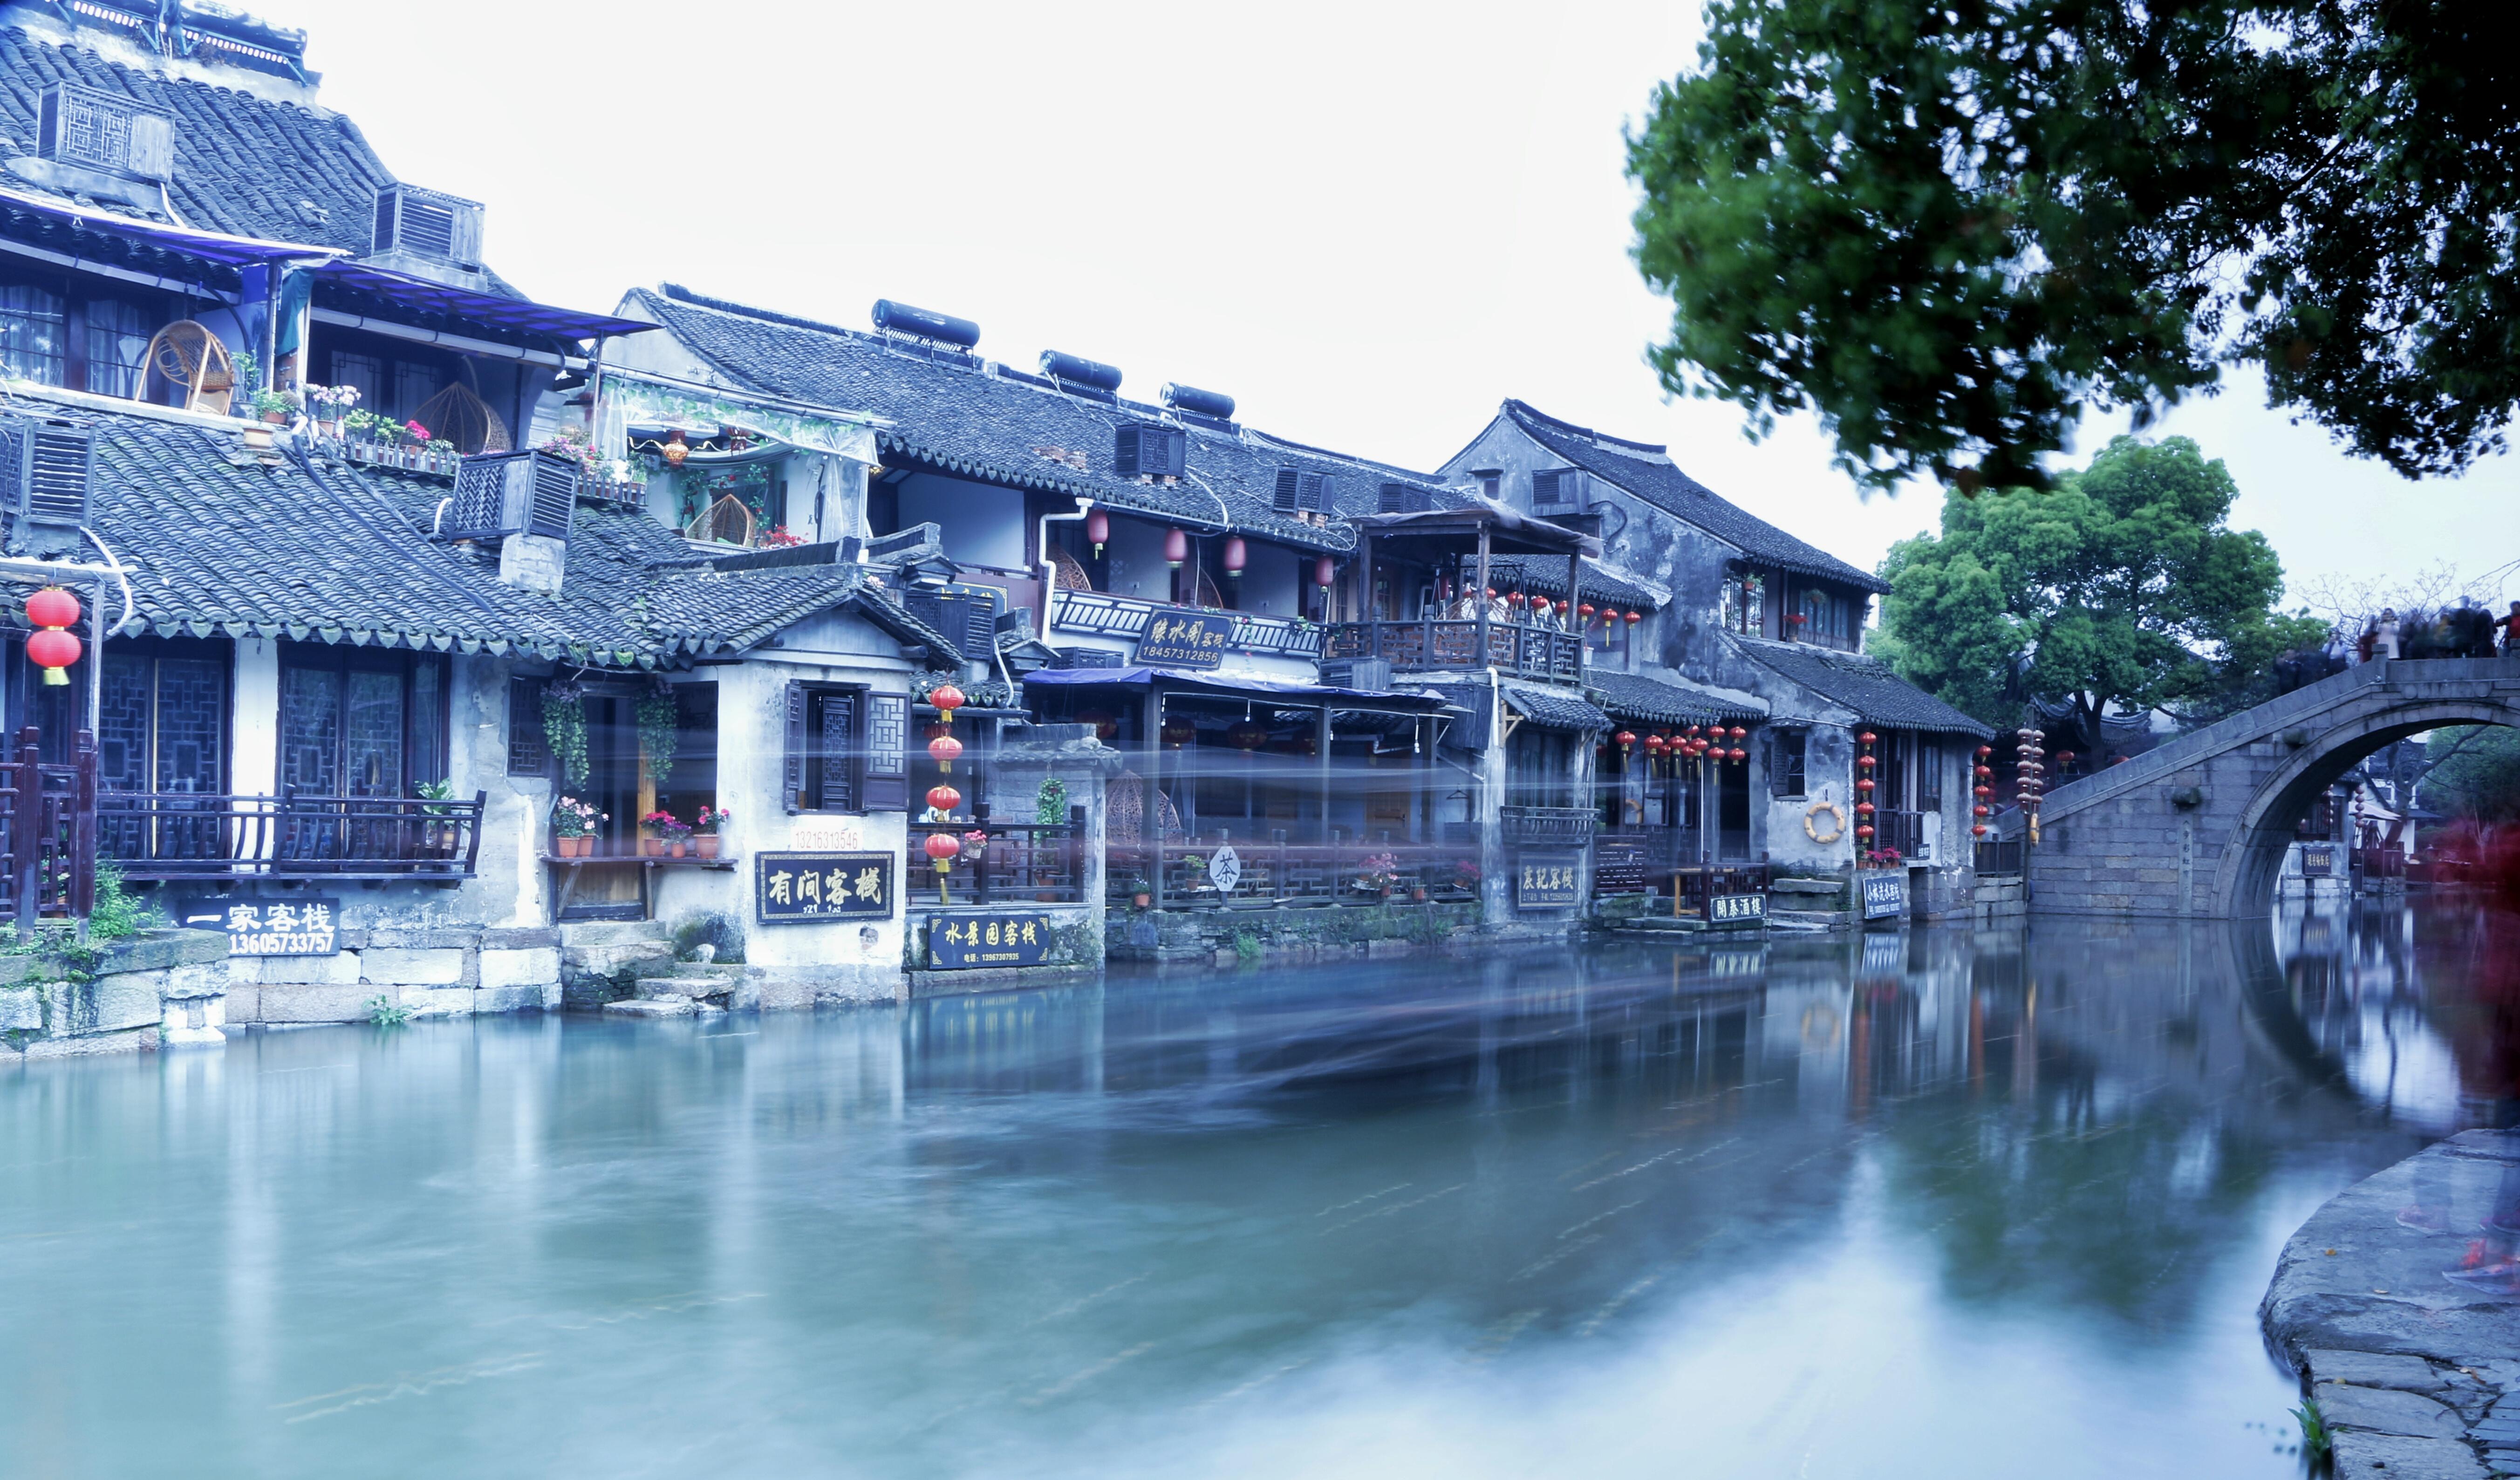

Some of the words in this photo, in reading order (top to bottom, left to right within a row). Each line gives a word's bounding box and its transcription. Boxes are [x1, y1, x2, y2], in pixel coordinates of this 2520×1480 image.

[1143, 646, 1218, 662] 18457312856
[795, 831, 858, 850] 13216313546
[1215, 852, 1237, 884] 茶
[187, 903, 335, 932] 一家客栈
[229, 933, 334, 954] 13605733757
[982, 953, 1019, 961] 13967307935
